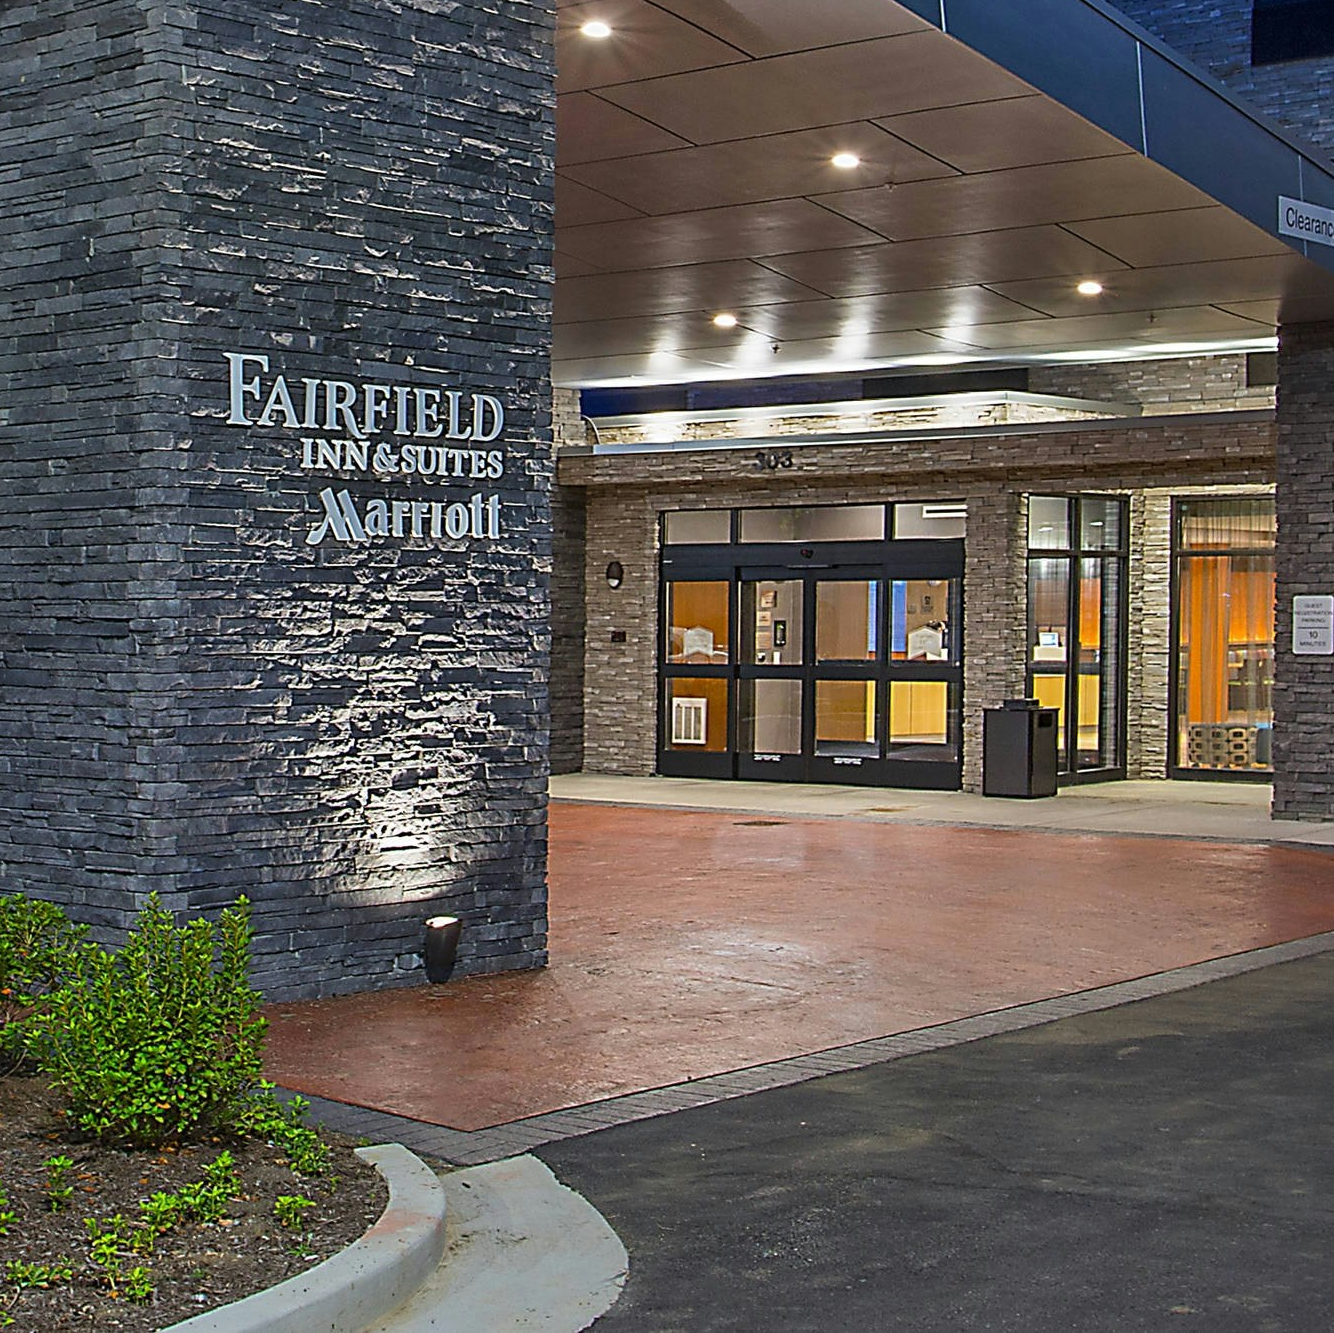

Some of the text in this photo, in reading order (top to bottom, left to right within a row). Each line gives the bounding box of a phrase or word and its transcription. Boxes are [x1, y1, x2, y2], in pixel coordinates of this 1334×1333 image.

[222, 352, 505, 442] FAIRFIELD
[300, 437, 504, 479] INN & SUITES
[754, 451, 793, 470] 303
[305, 487, 502, 545] Marriott
[1309, 631, 1319, 639] 10
